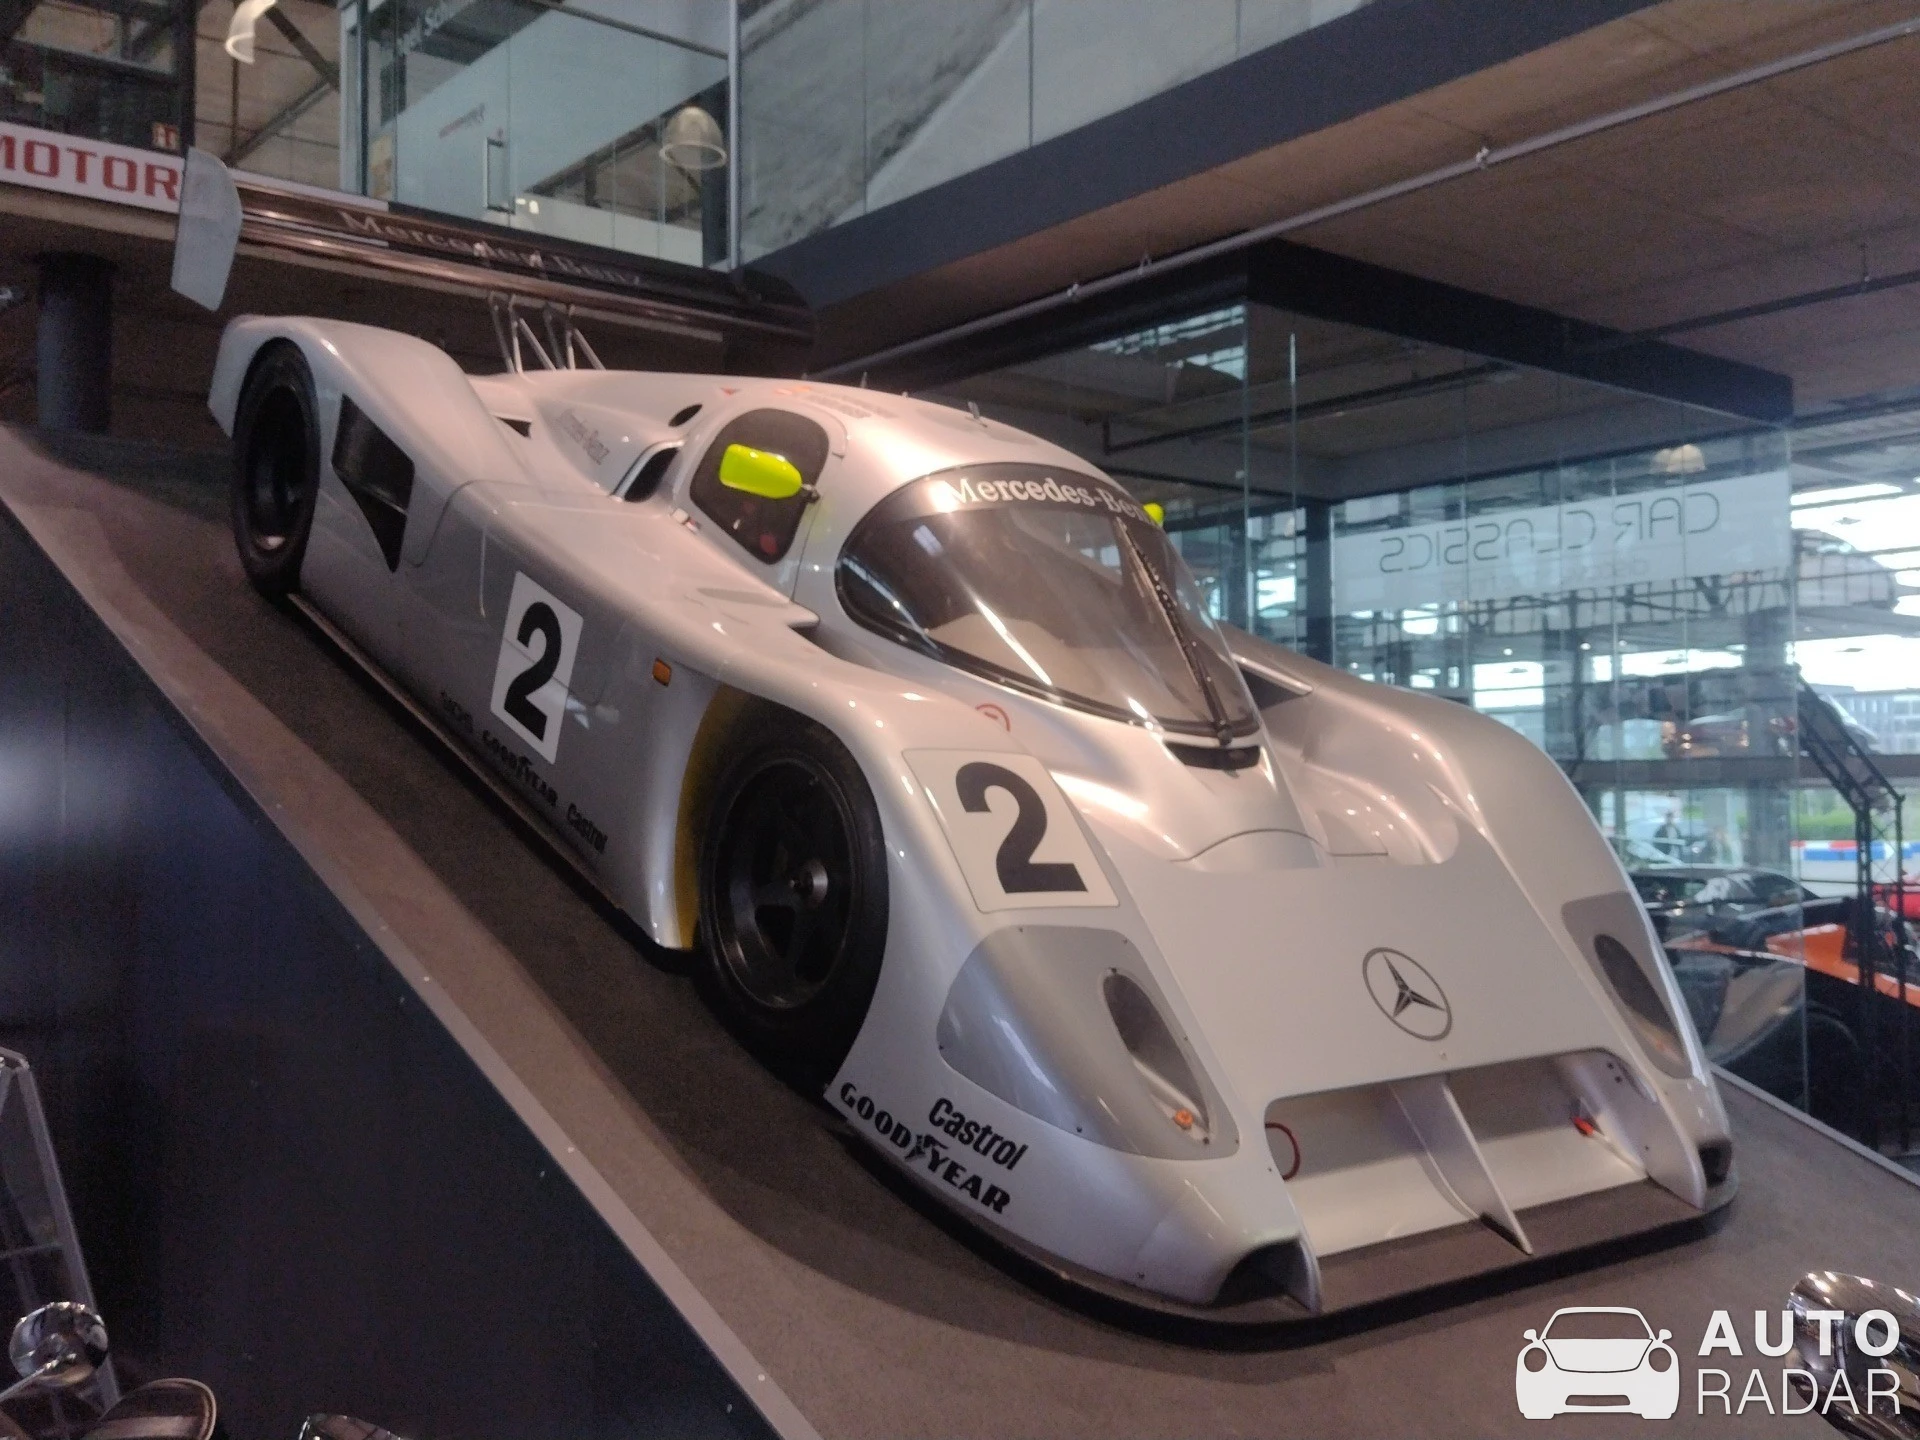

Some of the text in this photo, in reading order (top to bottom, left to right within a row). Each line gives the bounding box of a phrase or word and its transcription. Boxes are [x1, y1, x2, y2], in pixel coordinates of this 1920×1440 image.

[940, 477, 1157, 526] Mercedes-Ben
[504, 602, 562, 742] 2
[956, 762, 1088, 894] 2
[929, 1097, 1029, 1171] Castrol
